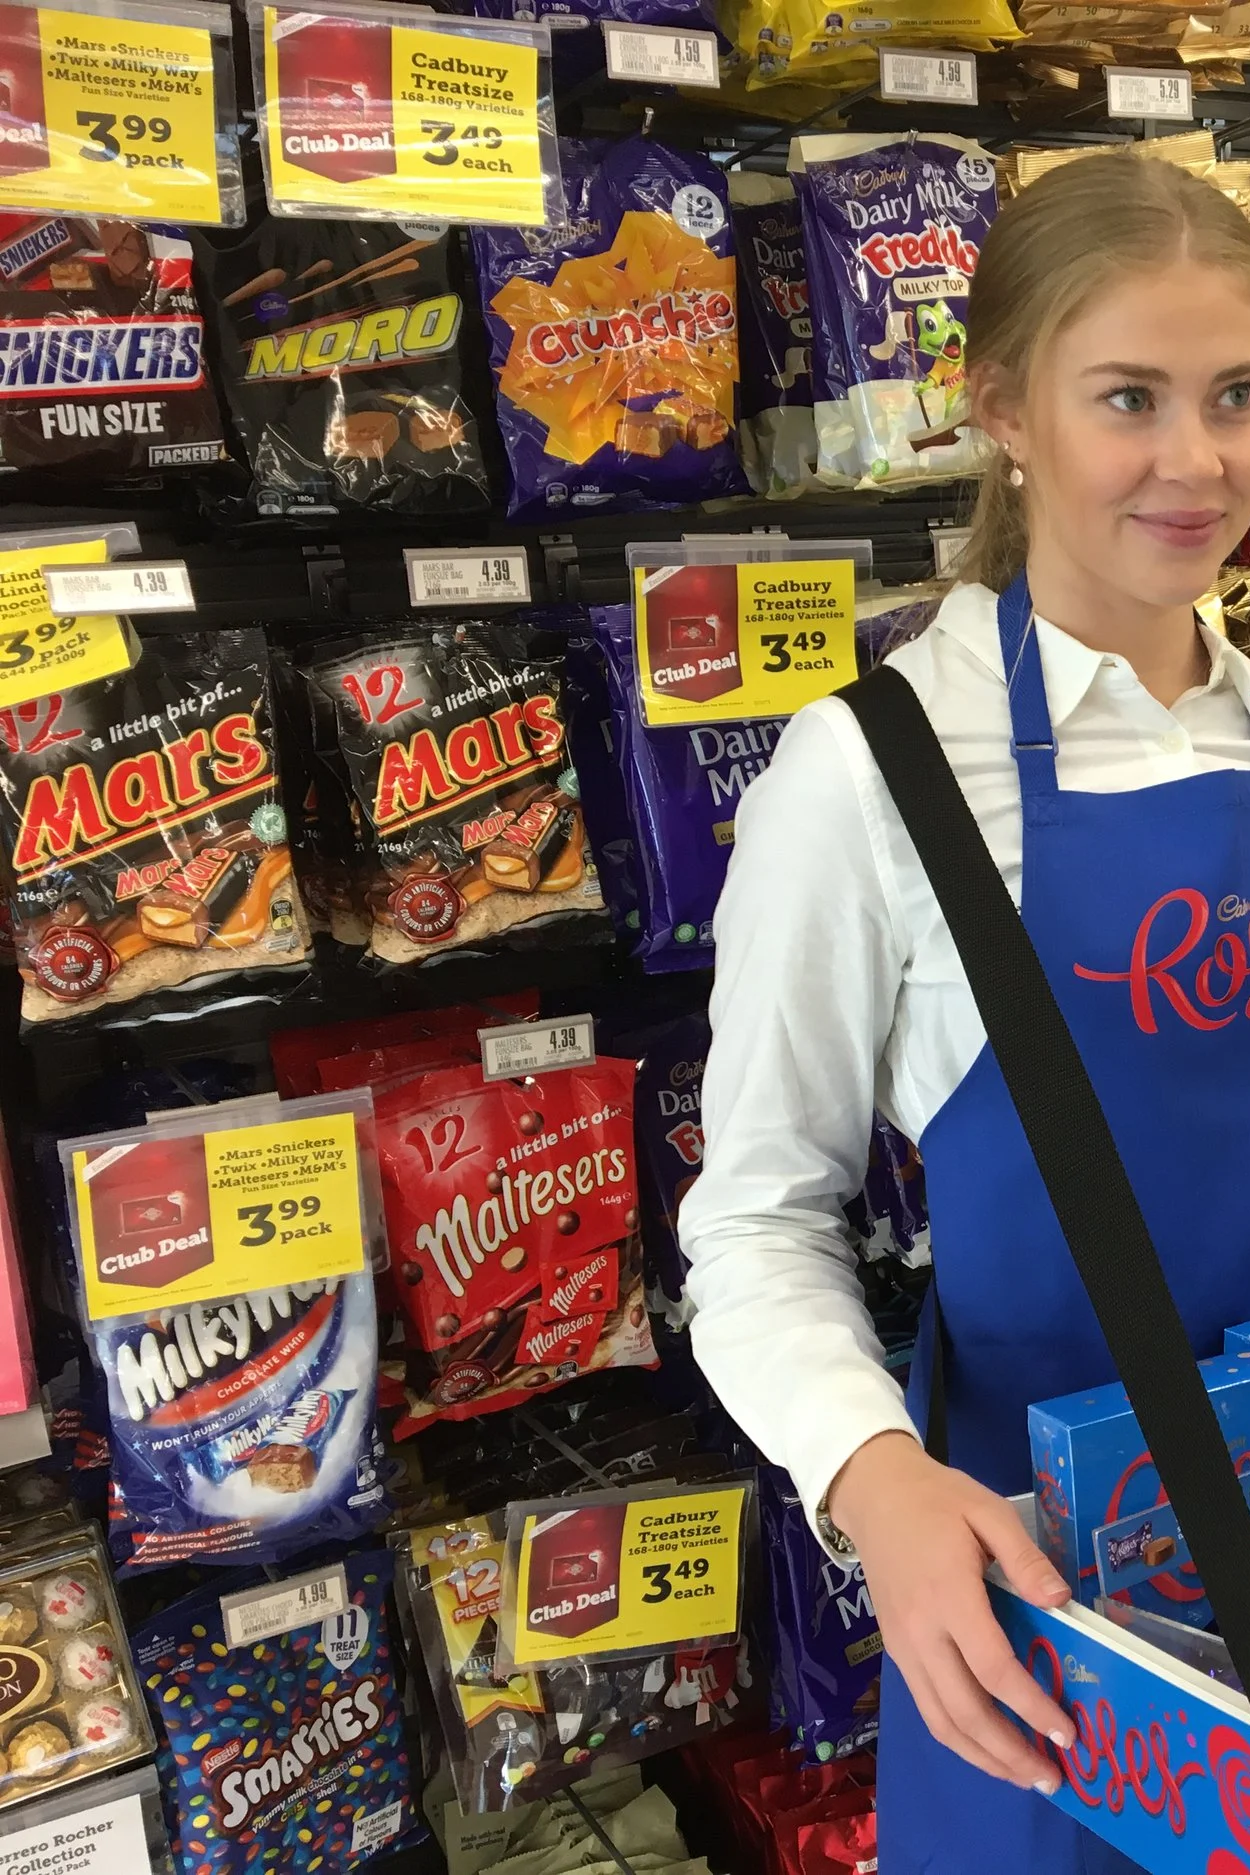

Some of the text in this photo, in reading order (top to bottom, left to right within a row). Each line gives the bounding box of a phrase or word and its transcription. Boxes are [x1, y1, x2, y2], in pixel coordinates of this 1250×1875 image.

[672, 37, 700, 63] 4.59
[411, 52, 508, 83] Cadbury
[938, 60, 960, 82] 4.59
[126, 91, 171, 103] Varieties
[411, 73, 514, 101] Treatsize
[1160, 79, 1180, 100] 5.29
[400, 91, 525, 117] 168-180g Varieties
[285, 131, 392, 156] Club Deal
[126, 152, 184, 169] pack
[462, 156, 513, 174] each
[962, 156, 987, 177] 15
[684, 192, 716, 222] 12
[847, 163, 978, 231] Dairy Milk
[0, 220, 68, 275] SNICKERS
[900, 278, 965, 296] MILKY TOP
[244, 292, 462, 380] MORO
[40, 403, 100, 440] FUN
[153, 446, 211, 465] PACKED
[133, 571, 168, 593] 4.39
[481, 559, 511, 583] 4.39
[753, 579, 832, 596] Cadbury
[744, 609, 845, 624] 168-180g Varieties
[753, 595, 837, 613] Treatsize
[39, 631, 91, 663] pack
[30, 648, 86, 675] per 100g
[653, 650, 738, 686] Club Deal
[793, 656, 835, 672] each
[341, 663, 425, 726] 12
[431, 674, 513, 718] a little bit
[91, 701, 197, 752] a little bit
[373, 693, 566, 826] Mars
[13, 712, 268, 871] Mars
[461, 808, 517, 848] Mars
[502, 800, 557, 848] Mars
[116, 857, 182, 902] Mars
[163, 847, 232, 900] Mars
[17, 890, 44, 903] 216g
[549, 1027, 577, 1050] 4.39
[405, 1114, 484, 1176] 12
[497, 1118, 589, 1171] a little bit
[265, 1148, 344, 1172] Milky Way
[241, 1176, 319, 1194] Fun Size Varieties
[600, 1194, 622, 1206] 144g
[279, 1221, 333, 1245] pack
[416, 1146, 628, 1299] Maltesers
[100, 1226, 210, 1276] Club Deal
[548, 1253, 609, 1317] Maltesers
[525, 1310, 595, 1364] Maltesers
[216, 1331, 307, 1400] CHOCOLATE WHIP
[150, 1406, 248, 1451] WON'T RUIN YOUR
[209, 1519, 252, 1536] COLOURS
[639, 1508, 720, 1530] Cadbury
[209, 1531, 255, 1547] FLAVOURS
[628, 1535, 729, 1557] 168-180g Varieties
[638, 1523, 722, 1546] Treatsize
[299, 1581, 328, 1602] 4.99
[449, 1558, 502, 1604] 12
[673, 1583, 716, 1601] each
[529, 1583, 617, 1626] Club Deal
[330, 1639, 360, 1652] TREAT
[335, 1651, 354, 1662] SIZE
[220, 1679, 380, 1830] SMARTIES
[251, 1761, 349, 1835] yummy milk chocolate
[316, 1782, 338, 1800] shell
[368, 1805, 399, 1827] Artificial
[52, 1820, 114, 1848] Rocher
[364, 1821, 388, 1838] Colours
[367, 1827, 393, 1844] Flavours
[6, 1842, 97, 1875] Collection
[66, 1859, 91, 1873] Pack
